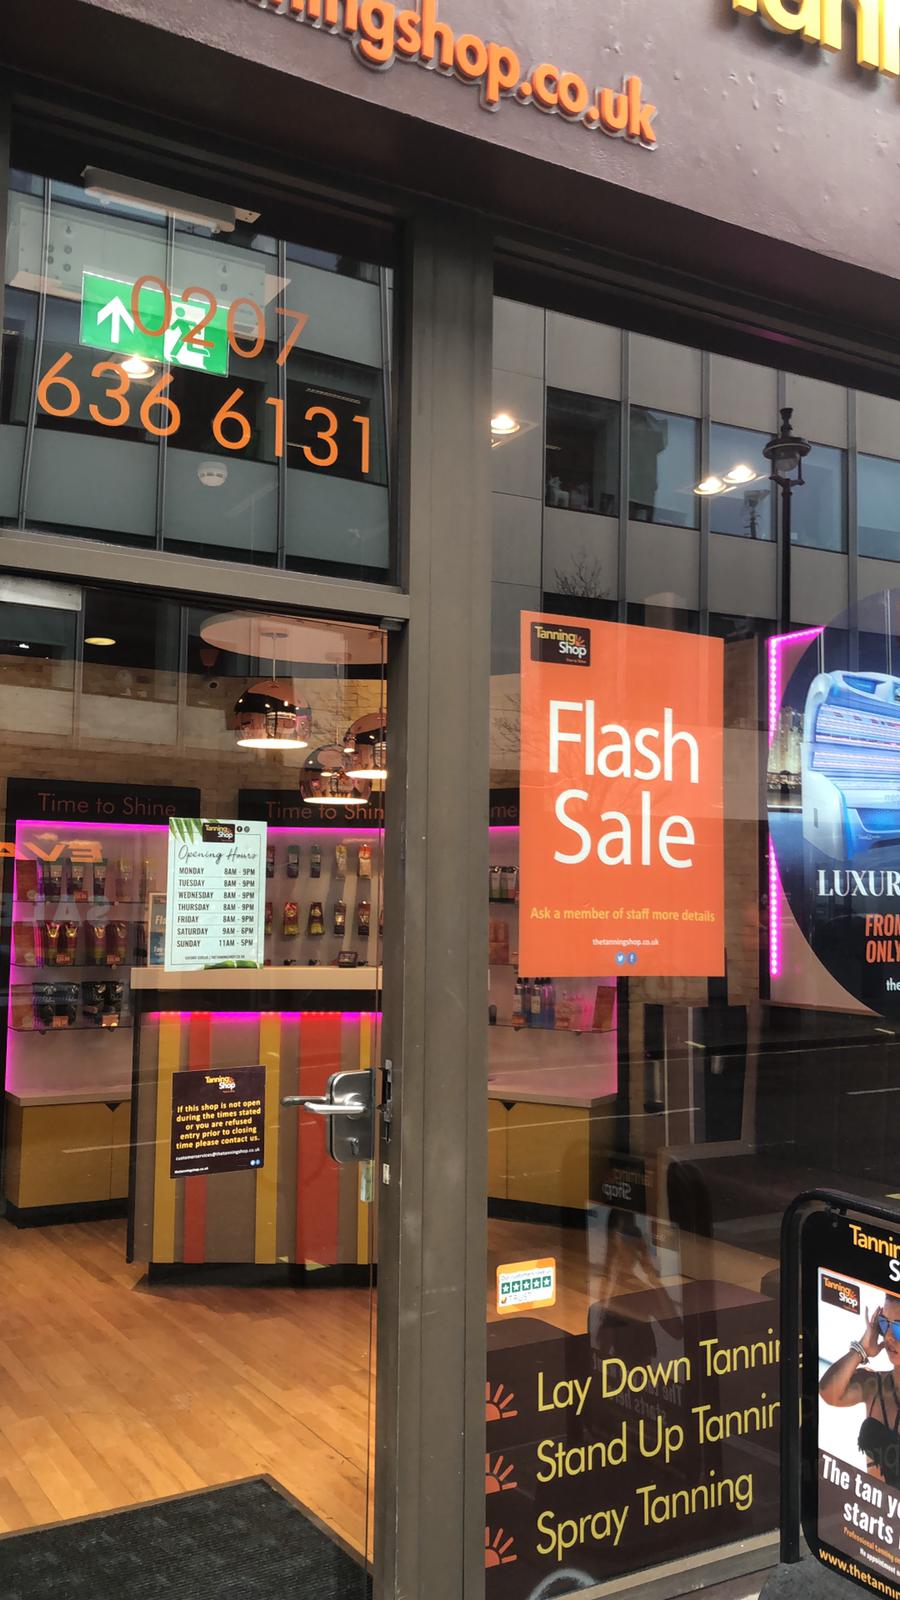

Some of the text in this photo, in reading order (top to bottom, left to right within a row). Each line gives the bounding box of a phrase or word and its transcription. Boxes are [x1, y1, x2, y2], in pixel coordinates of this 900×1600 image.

[131, 274, 310, 367] 0207
[37, 351, 371, 474] 636 6131
[533, 625, 577, 645] Tanning
[559, 641, 587, 658] Shop
[548, 699, 699, 784] Flash
[38, 792, 177, 817] Time to Shine
[265, 801, 385, 820] Time to Shin
[204, 824, 229, 834] Tanning
[217, 831, 233, 840] Shop
[553, 788, 696, 869] Sale
[178, 844, 257, 865] Opening Hours
[179, 867, 205, 875] MONDAY
[224, 868, 237, 876] 8AM
[179, 879, 205, 887] TUESDAY
[224, 880, 236, 888] 8AM
[817, 869, 900, 897] LUXUR
[178, 891, 214, 899] WEDNESDAY
[223, 892, 236, 900] 8AM
[178, 903, 210, 911] THURSDAY
[223, 903, 236, 911] 8AM
[530, 907, 716, 922] Ask a member of staff more details
[177, 915, 199, 923] FRIDAY
[223, 915, 236, 923] 8AM
[177, 927, 208, 935] SATURDAY
[222, 927, 236, 935] 9AM
[177, 940, 201, 948] SUNDAY
[592, 938, 660, 947] thetanningshop.co.uk
[205, 1075, 230, 1084] Tanning
[219, 1082, 236, 1091] Shop
[185, 1104, 199, 1112] this
[201, 1103, 219, 1113] shop
[229, 1101, 241, 1109] not
[243, 1100, 261, 1109] open
[176, 1114, 201, 1122] during
[202, 1112, 215, 1120] the
[196, 1122, 209, 1131] you
[225, 1117, 252, 1126] refused
[180, 1132, 200, 1140] entry
[202, 1130, 220, 1139] prior
[232, 1126, 257, 1136] closing
[176, 1142, 193, 1150] time
[195, 1139, 219, 1149] please
[221, 1136, 248, 1145] contact
[823, 1277, 852, 1297] Tanning
[839, 1292, 858, 1308] Shop
[537, 1371, 592, 1415] Lay
[602, 1356, 691, 1399] Down
[536, 1391, 781, 1483] Stand Up Tannin
[822, 1453, 850, 1490] The
[855, 1473, 883, 1509] tan
[536, 1469, 752, 1561] Spray Tanning
[843, 1502, 894, 1545] starts
